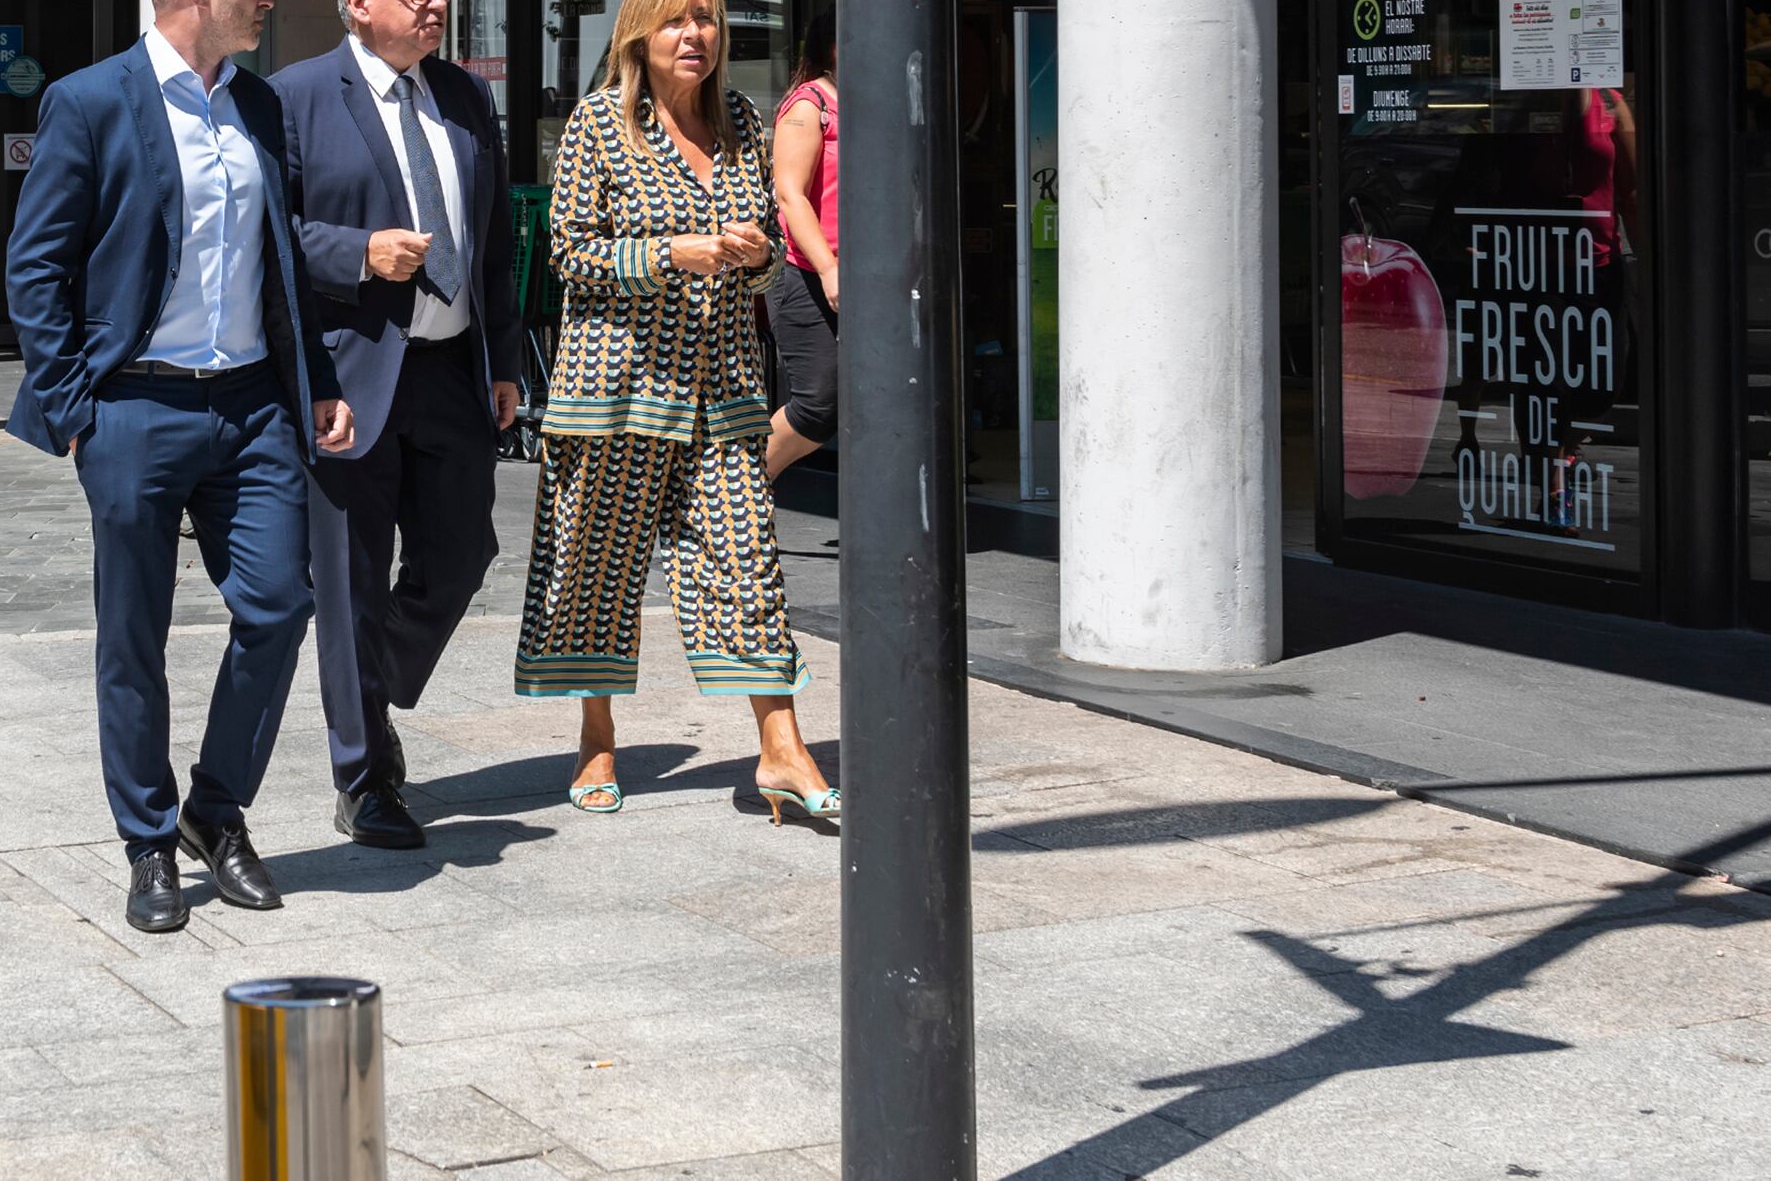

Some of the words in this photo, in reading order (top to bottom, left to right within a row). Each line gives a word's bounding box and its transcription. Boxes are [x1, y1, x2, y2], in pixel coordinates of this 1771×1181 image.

[1385, 0, 1394, 16] EL
[1347, 48, 1356, 63] DE
[1358, 46, 1387, 63] DILLUNS
[1389, 46, 1394, 61] A
[1396, 44, 1431, 61] DISSABTE
[1373, 89, 1409, 107] DIUMENGE
[1471, 224, 1595, 295] FRUITA
[1455, 299, 1615, 392] FRESCA
[1527, 394, 1559, 447] DE
[1458, 447, 1615, 532] QUALITAT
